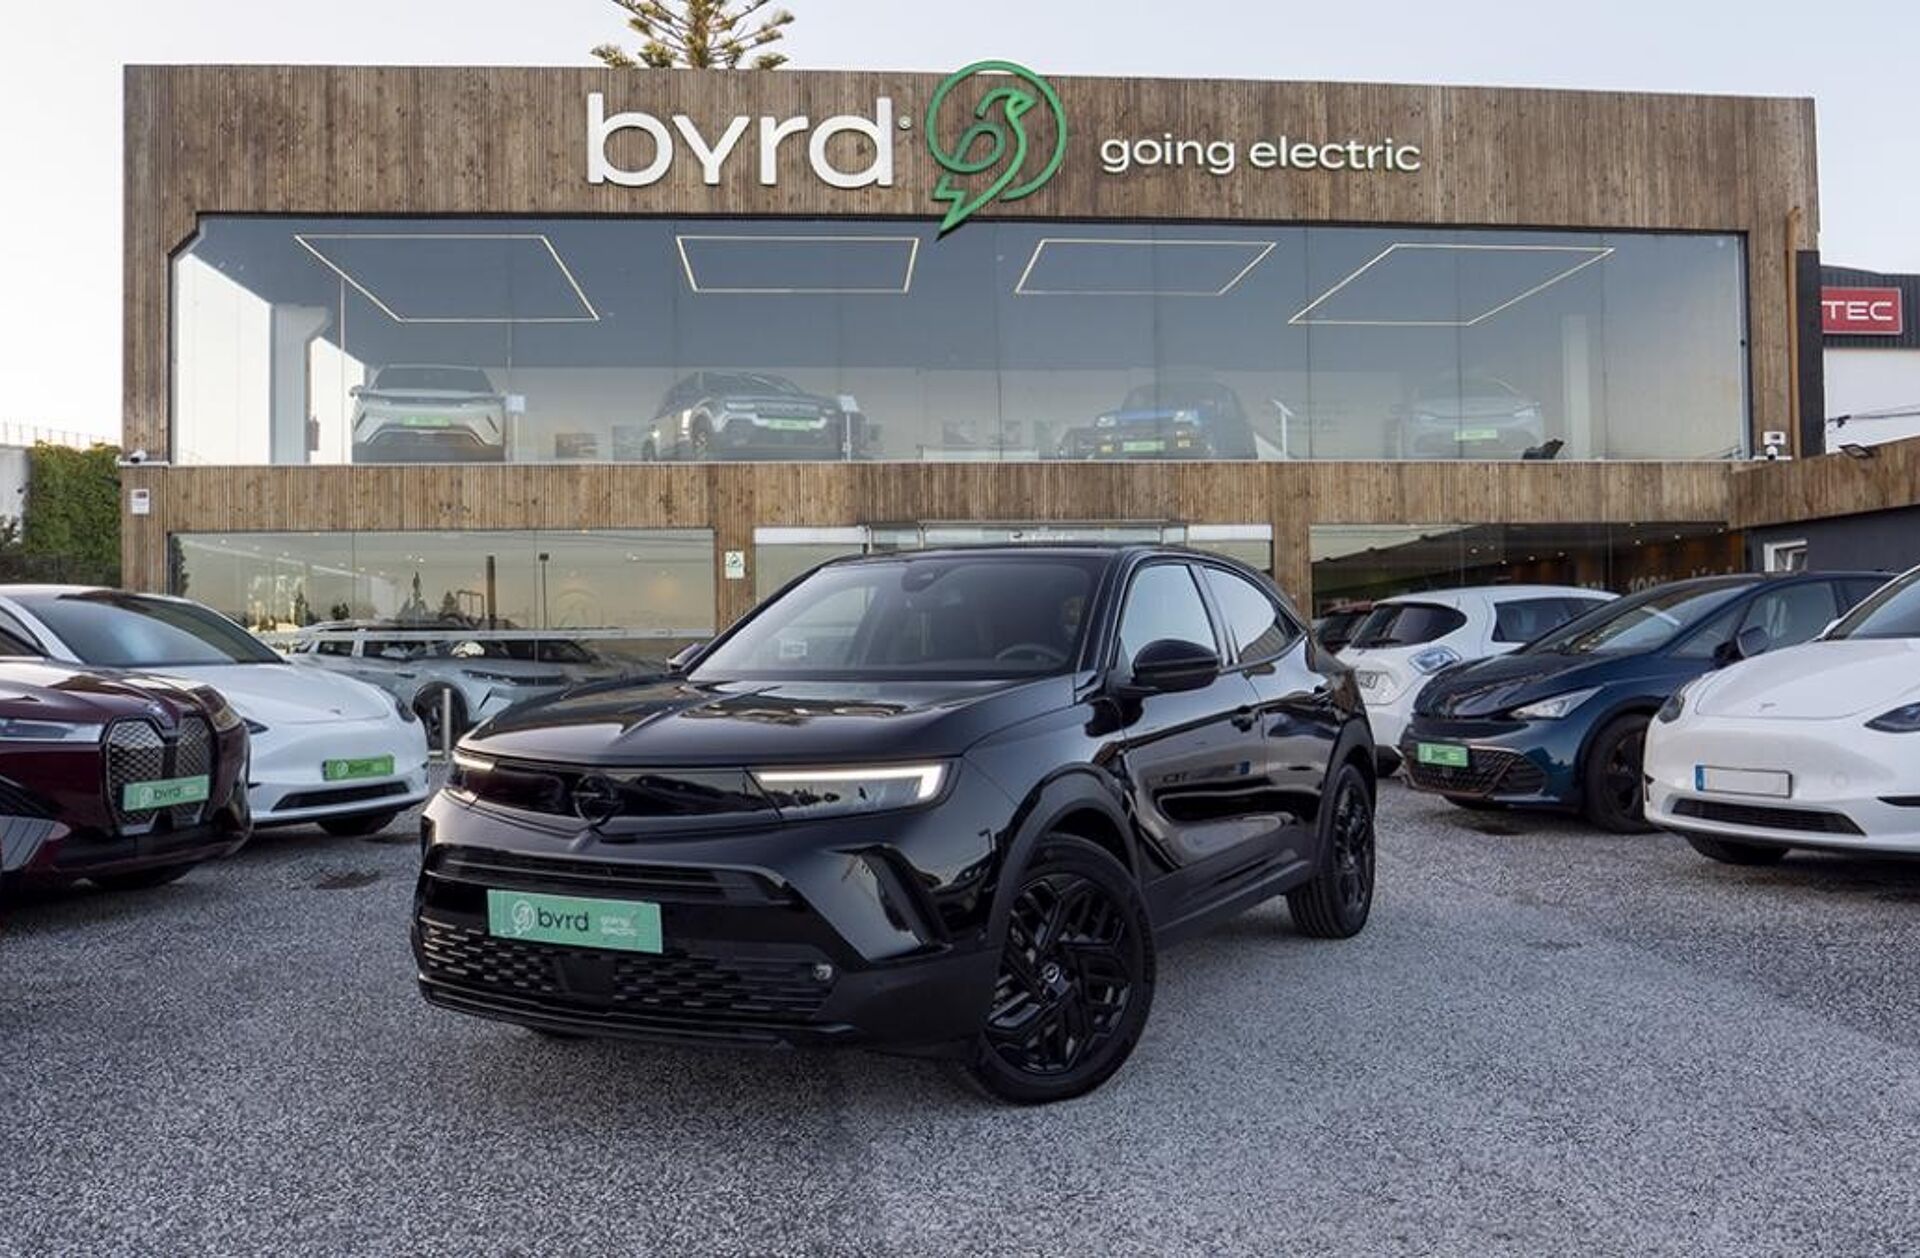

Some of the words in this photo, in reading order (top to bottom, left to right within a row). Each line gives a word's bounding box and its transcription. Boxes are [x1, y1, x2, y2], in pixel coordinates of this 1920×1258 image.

[587, 92, 893, 188] byrd
[1100, 133, 1236, 175] going
[1249, 135, 1421, 171] electric
[1821, 301, 1894, 321] TEC
[537, 907, 589, 932] byrd
